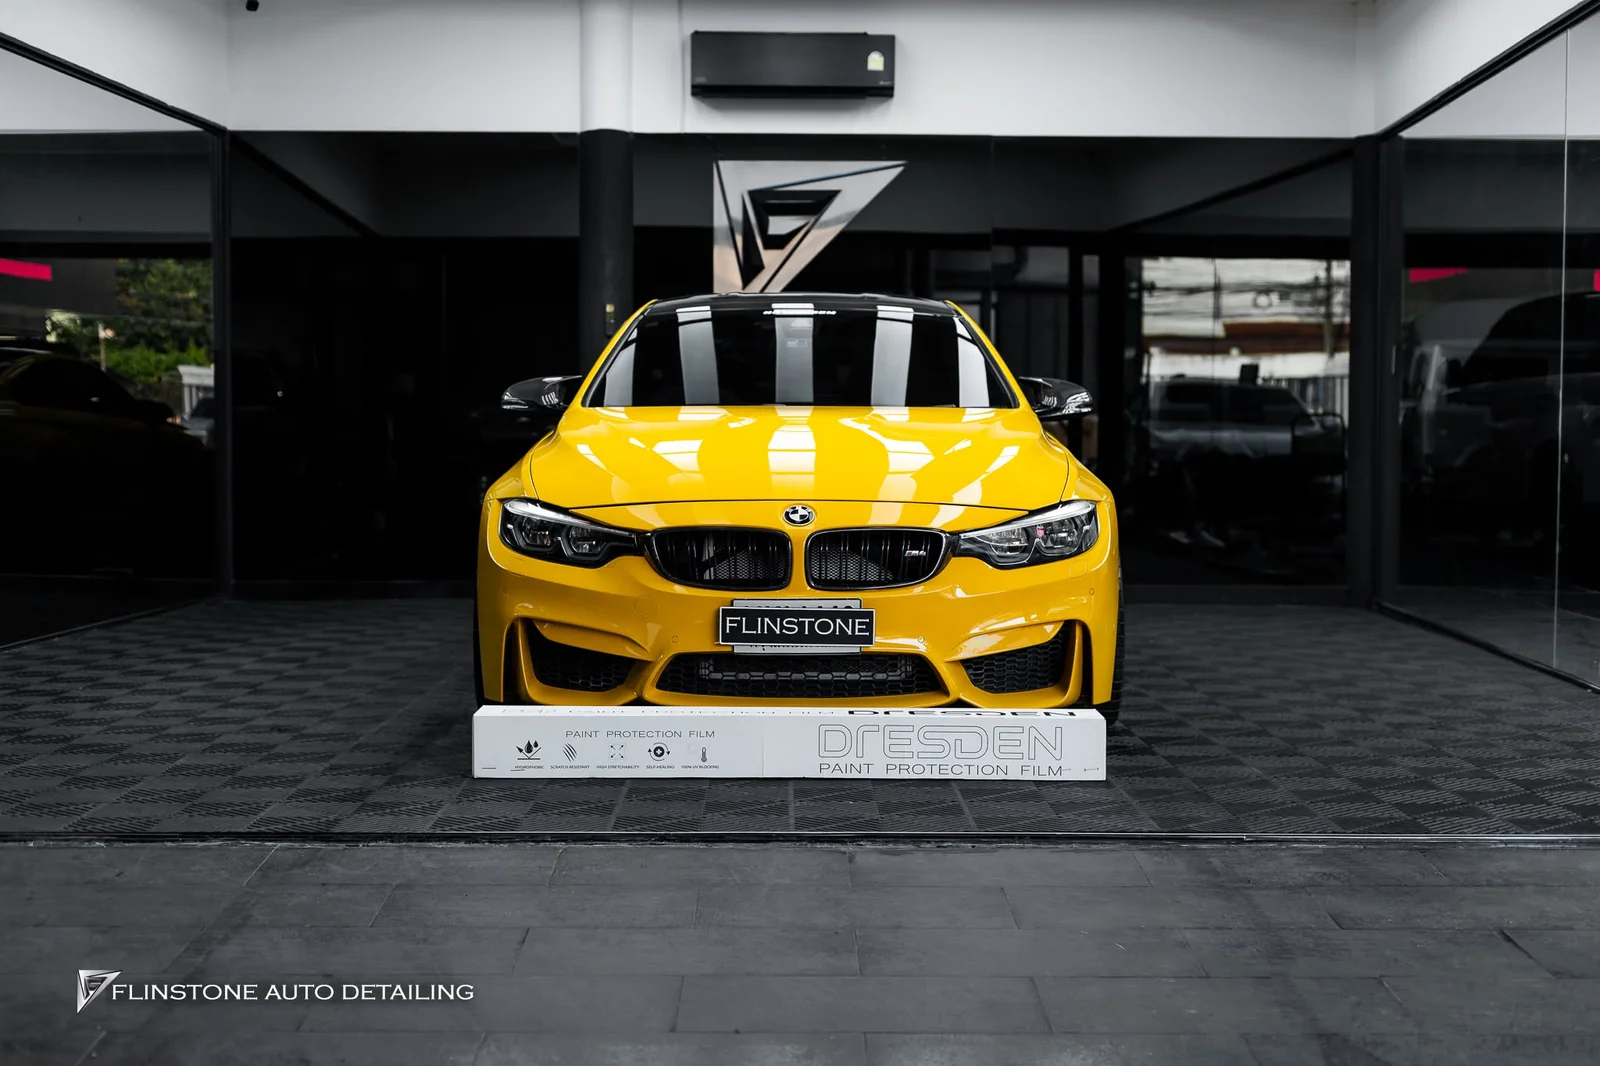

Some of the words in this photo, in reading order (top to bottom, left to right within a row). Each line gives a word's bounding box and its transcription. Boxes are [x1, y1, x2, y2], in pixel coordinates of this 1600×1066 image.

[725, 616, 870, 636] FLINSTONE
[565, 730, 600, 738] PAINT
[606, 730, 682, 738] PROTECTION
[689, 730, 715, 738] FILM
[819, 763, 874, 774] PAINT
[886, 764, 1008, 776] PROTECTION
[1021, 765, 1062, 776] FILM
